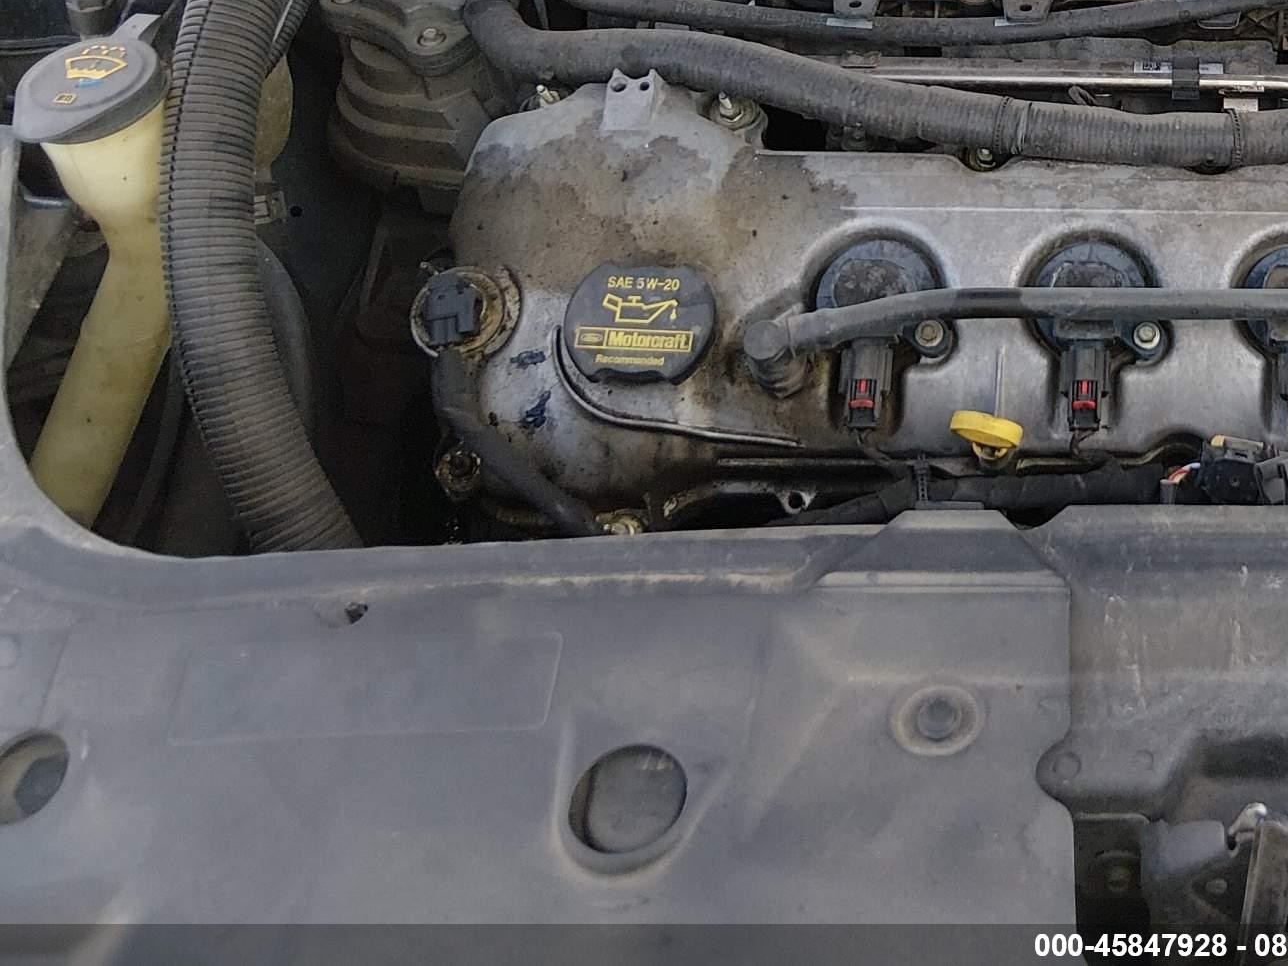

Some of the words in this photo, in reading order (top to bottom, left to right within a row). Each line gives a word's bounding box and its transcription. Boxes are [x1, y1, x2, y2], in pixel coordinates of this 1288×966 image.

[607, 276, 633, 289] SAE
[636, 277, 680, 291] 5W-20
[608, 331, 690, 349] Motorcraft
[594, 353, 665, 367] Recommended
